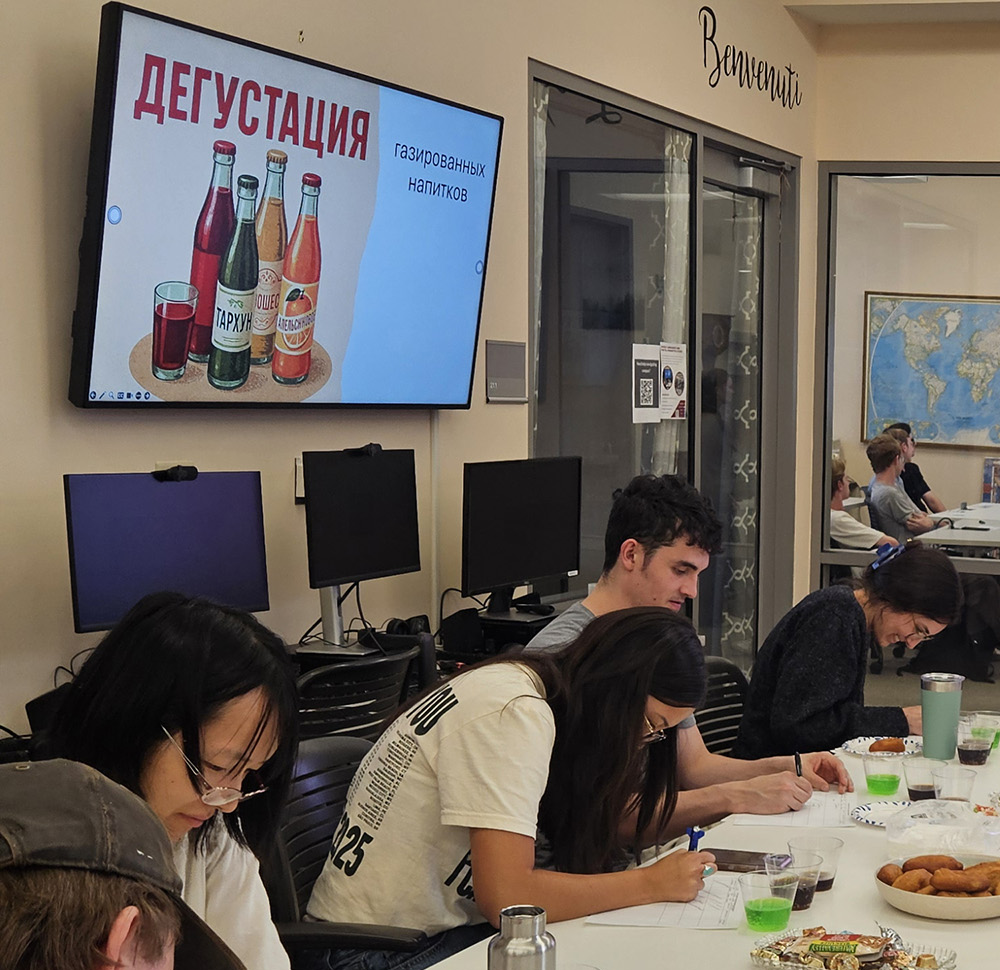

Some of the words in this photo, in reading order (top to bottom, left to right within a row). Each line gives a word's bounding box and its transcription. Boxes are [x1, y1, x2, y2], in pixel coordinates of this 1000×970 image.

[698, 5, 803, 110] Benvenuti
[133, 53, 370, 160] ДЕГУСТАЦИЯ
[394, 140, 486, 178] газированных
[407, 176, 468, 203] напитков
[216, 307, 252, 332] ТАРХУН
